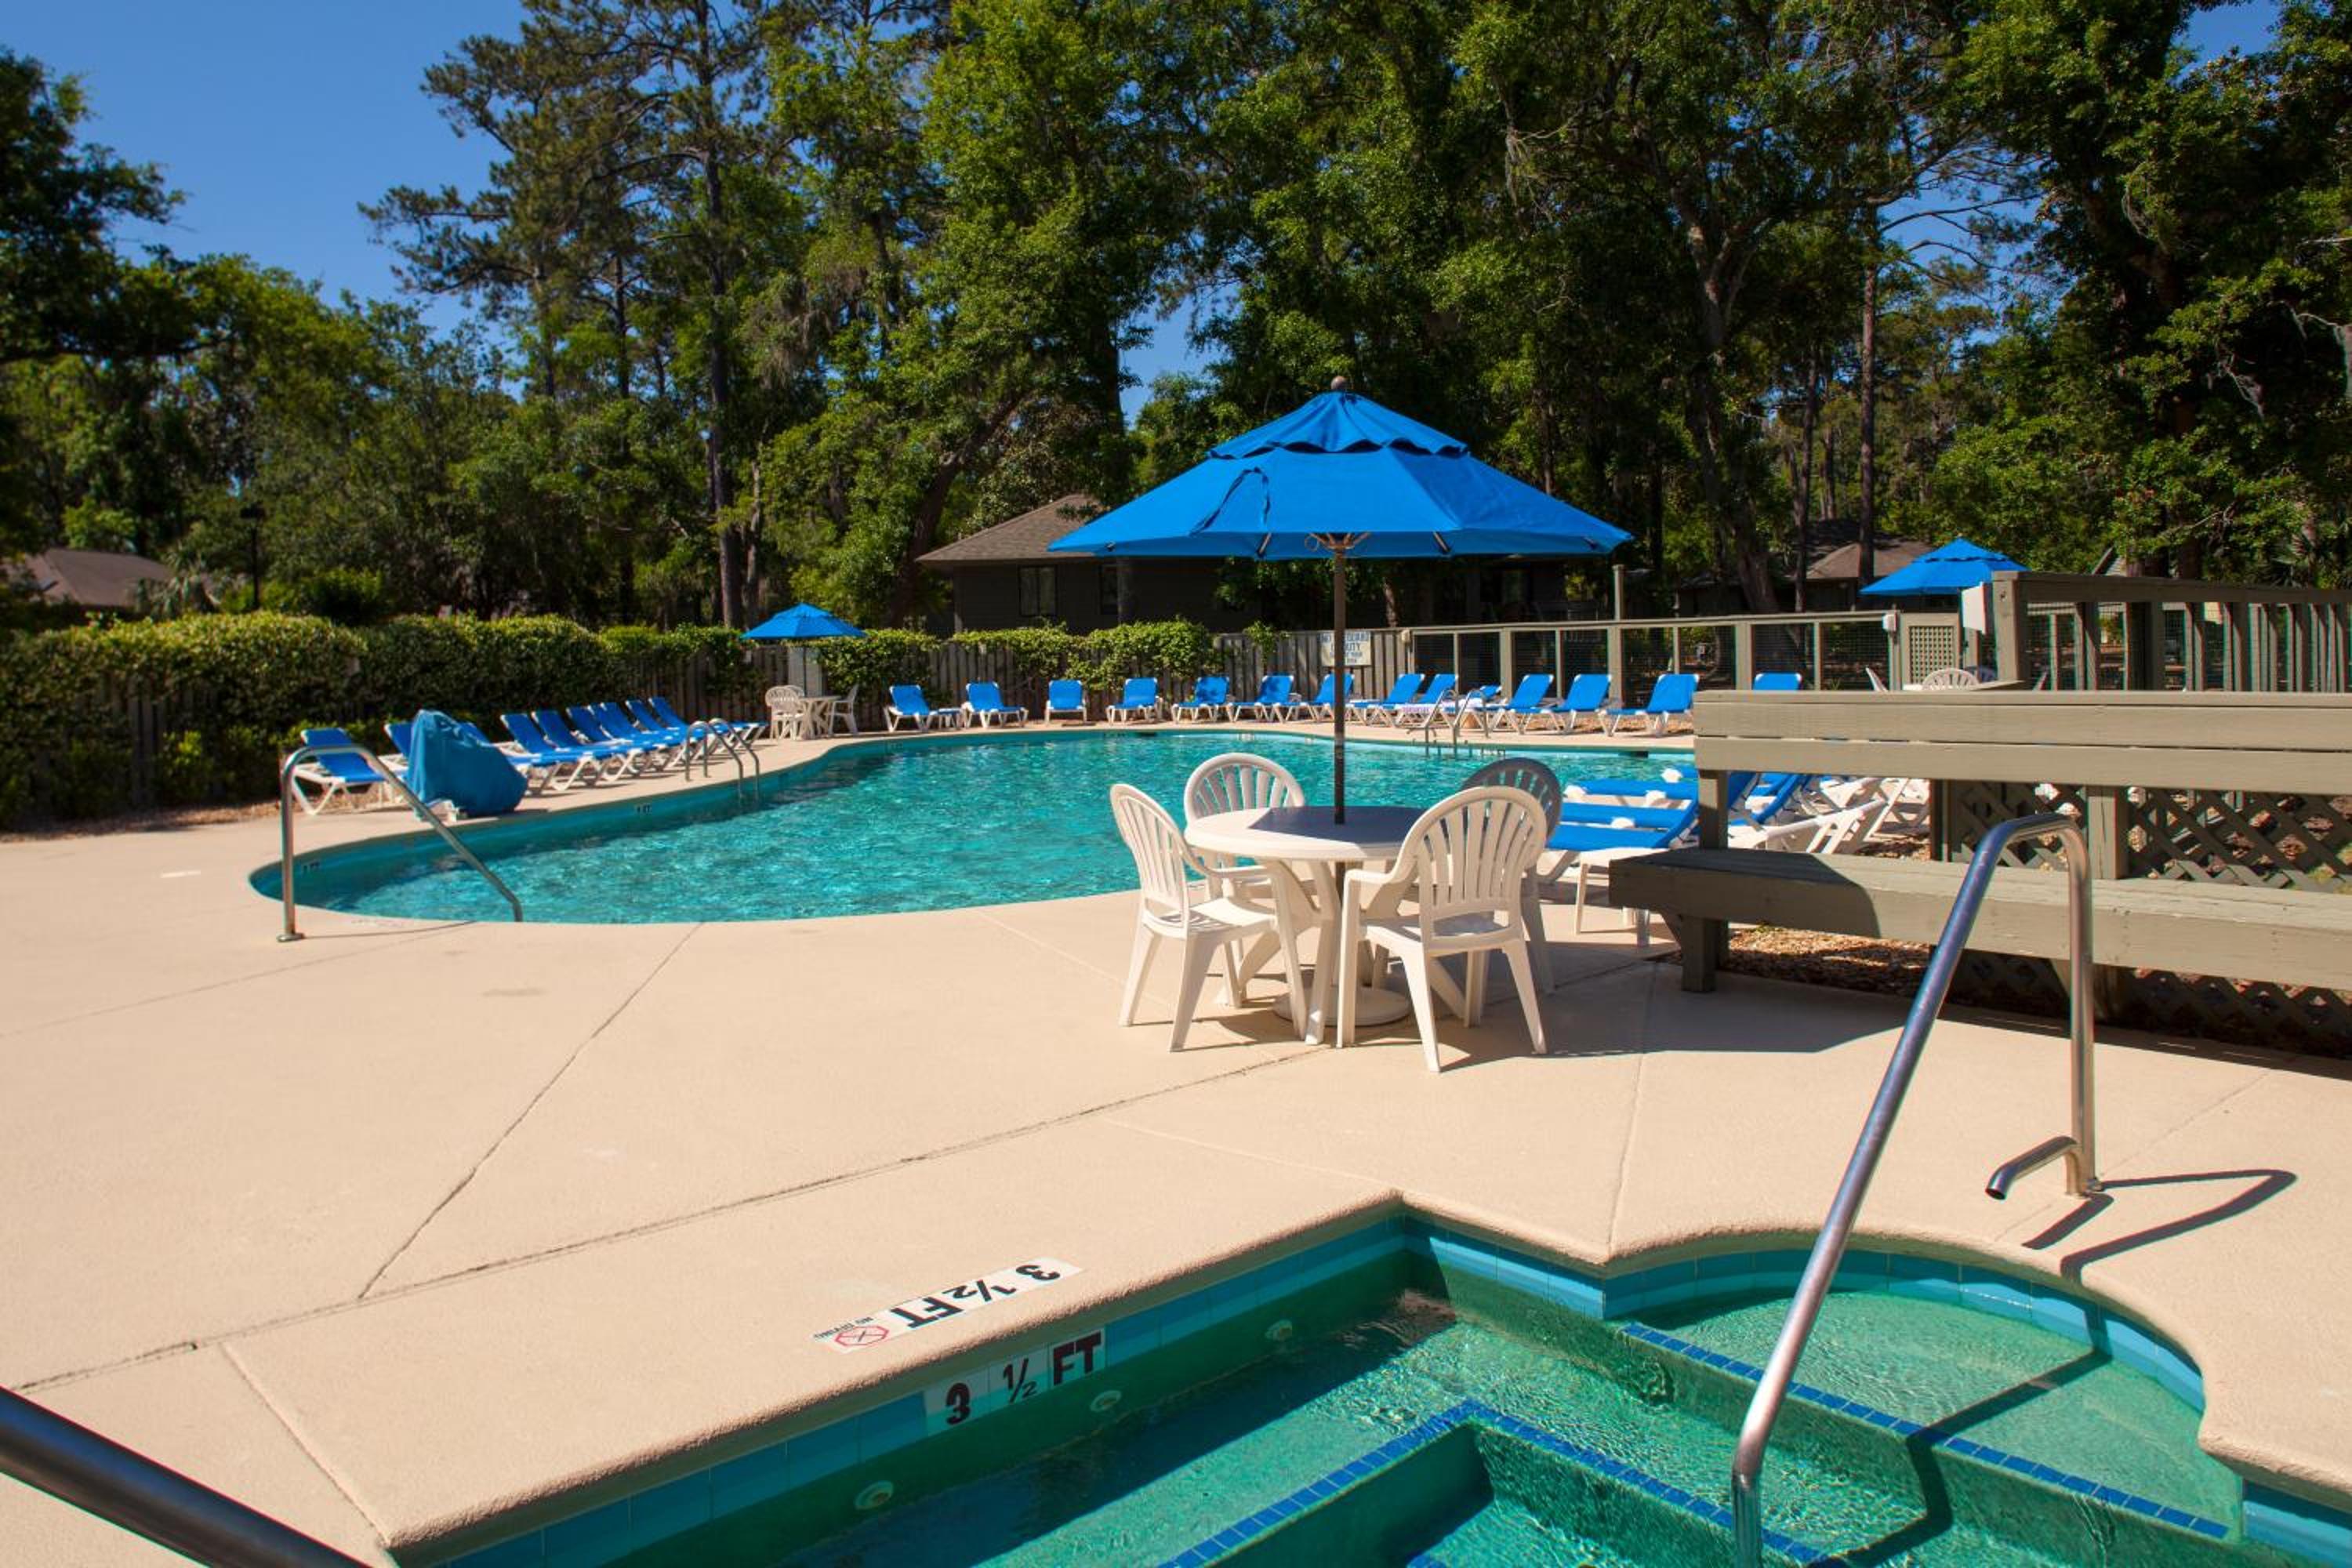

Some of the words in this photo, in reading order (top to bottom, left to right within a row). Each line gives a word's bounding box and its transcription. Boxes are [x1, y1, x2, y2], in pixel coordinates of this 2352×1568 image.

[1015, 1264, 1061, 1281] 3
[890, 1296, 964, 1329] FT
[946, 1381, 971, 1425] 3
[1053, 1330, 1102, 1386] FT
